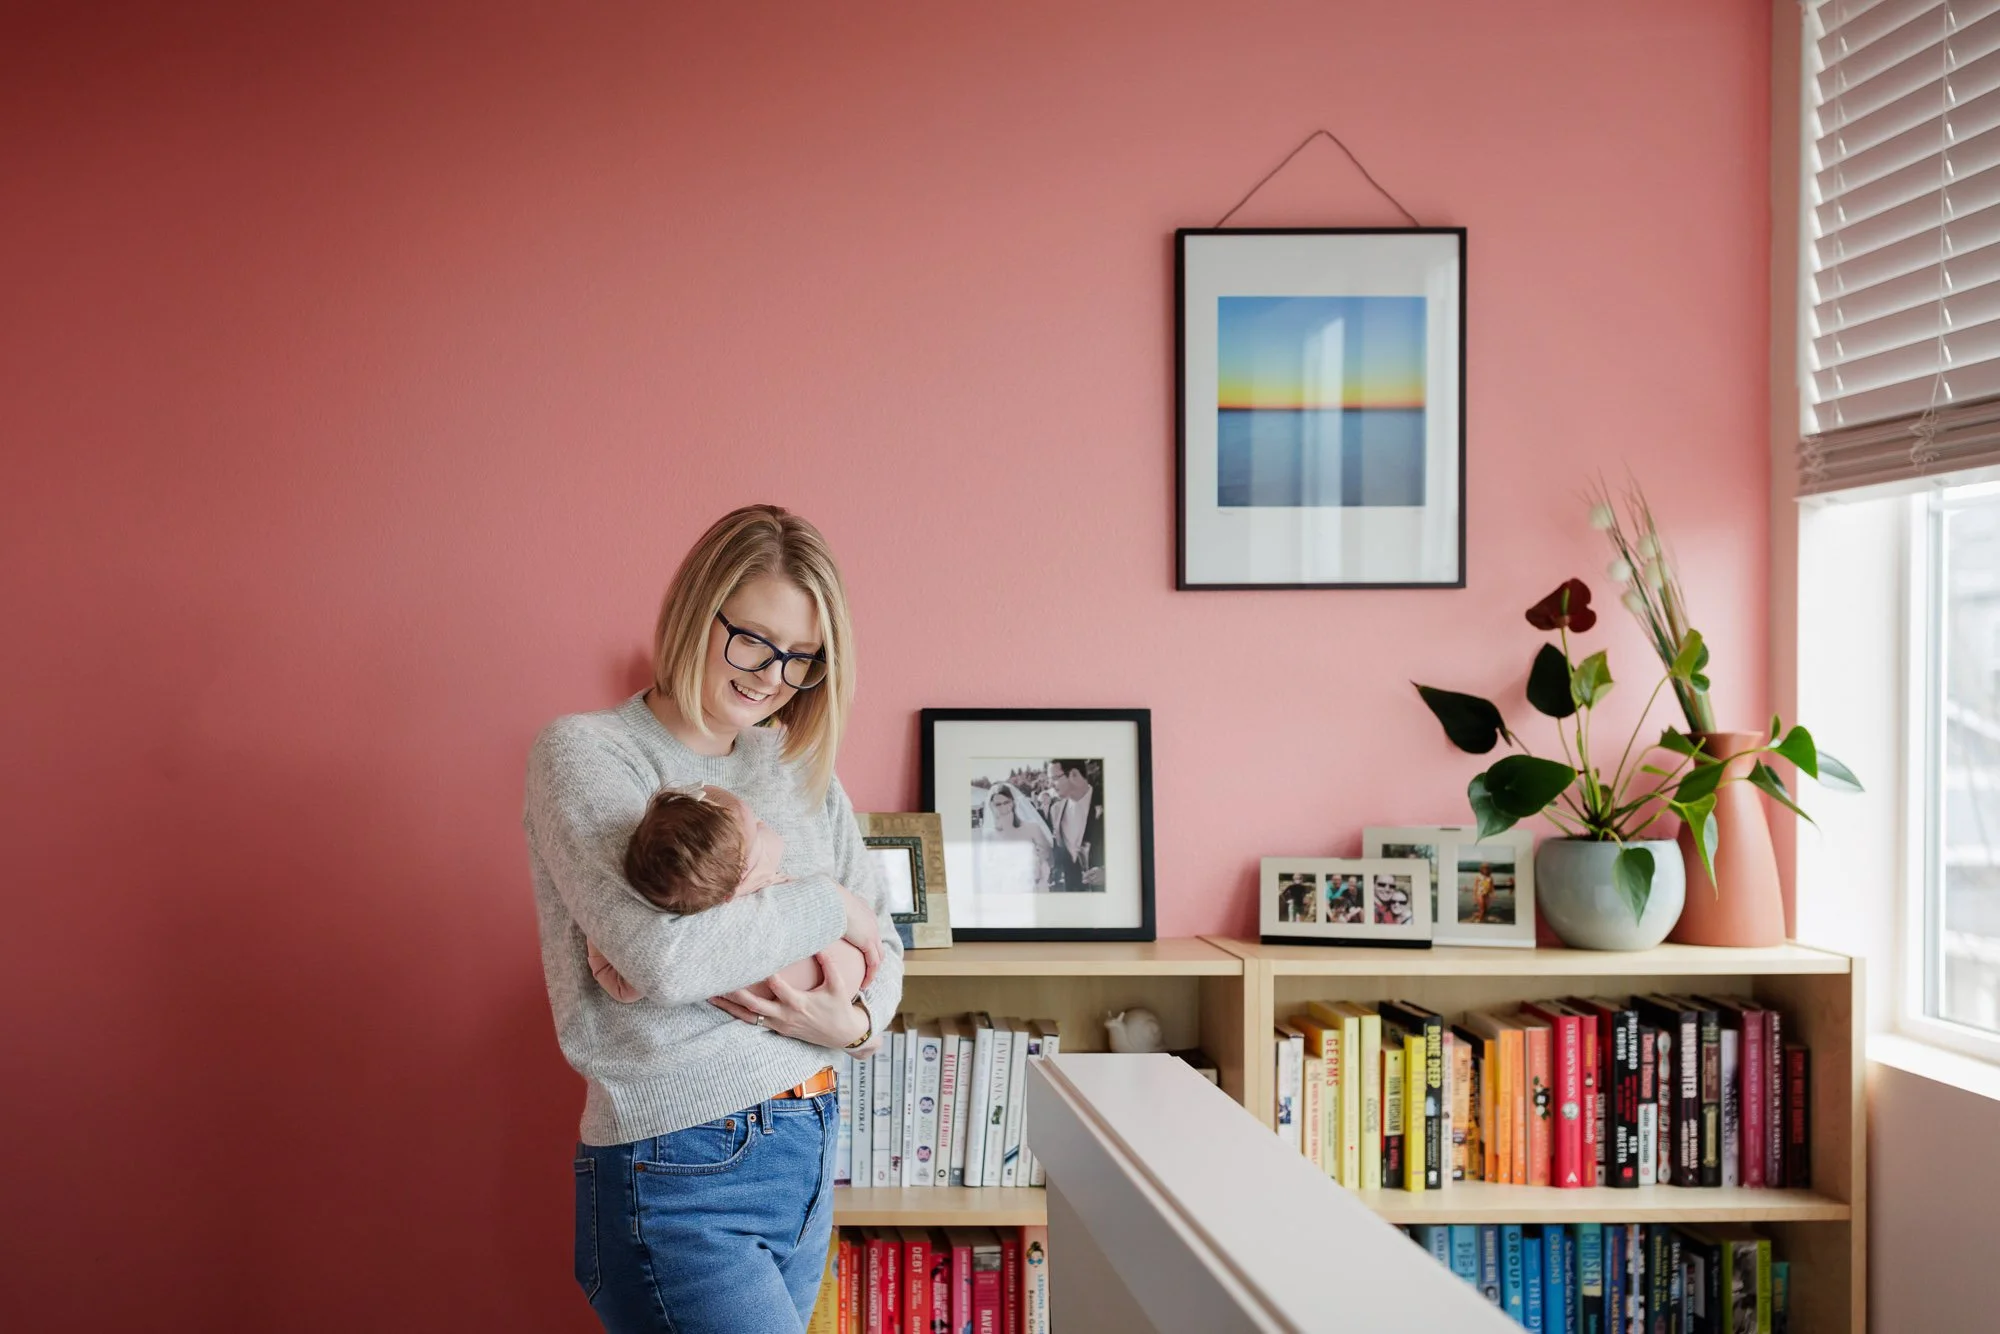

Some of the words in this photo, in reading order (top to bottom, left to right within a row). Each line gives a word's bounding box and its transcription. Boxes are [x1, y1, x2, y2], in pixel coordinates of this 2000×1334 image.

[1427, 1026, 1440, 1057] BONE
[1567, 1023, 1576, 1046] THE
[1617, 1027, 1626, 1061] ENDING
[1628, 1017, 1638, 1070] HOLLYWOOD
[998, 1043, 1008, 1064] EVIL
[1326, 1038, 1340, 1086] GERMS
[1682, 1023, 1697, 1099] MINDHUNTER
[943, 1054, 956, 1095] KILLINGS
[994, 1068, 1004, 1101] GENES
[1389, 1076, 1401, 1095] JOHN
[1427, 1059, 1440, 1088] DEEP
[1388, 1098, 1401, 1131] GRISHAM
[1617, 1126, 1626, 1164] AULETTA
[1629, 1136, 1638, 1153] KEN
[870, 1248, 878, 1286] CHELSEA
[888, 1248, 896, 1282] Jennifer
[912, 1247, 922, 1273] DEBT
[1508, 1232, 1520, 1289] GROUP
[1550, 1233, 1561, 1285] ORIGINS
[1583, 1233, 1601, 1287] CHOSEN
[1672, 1242, 1680, 1270] SARAH
[888, 1282, 896, 1313] Weiner
[1529, 1276, 1540, 1308] THE
[1671, 1272, 1680, 1306] VOWELL
[869, 1287, 878, 1327] HANDLER
